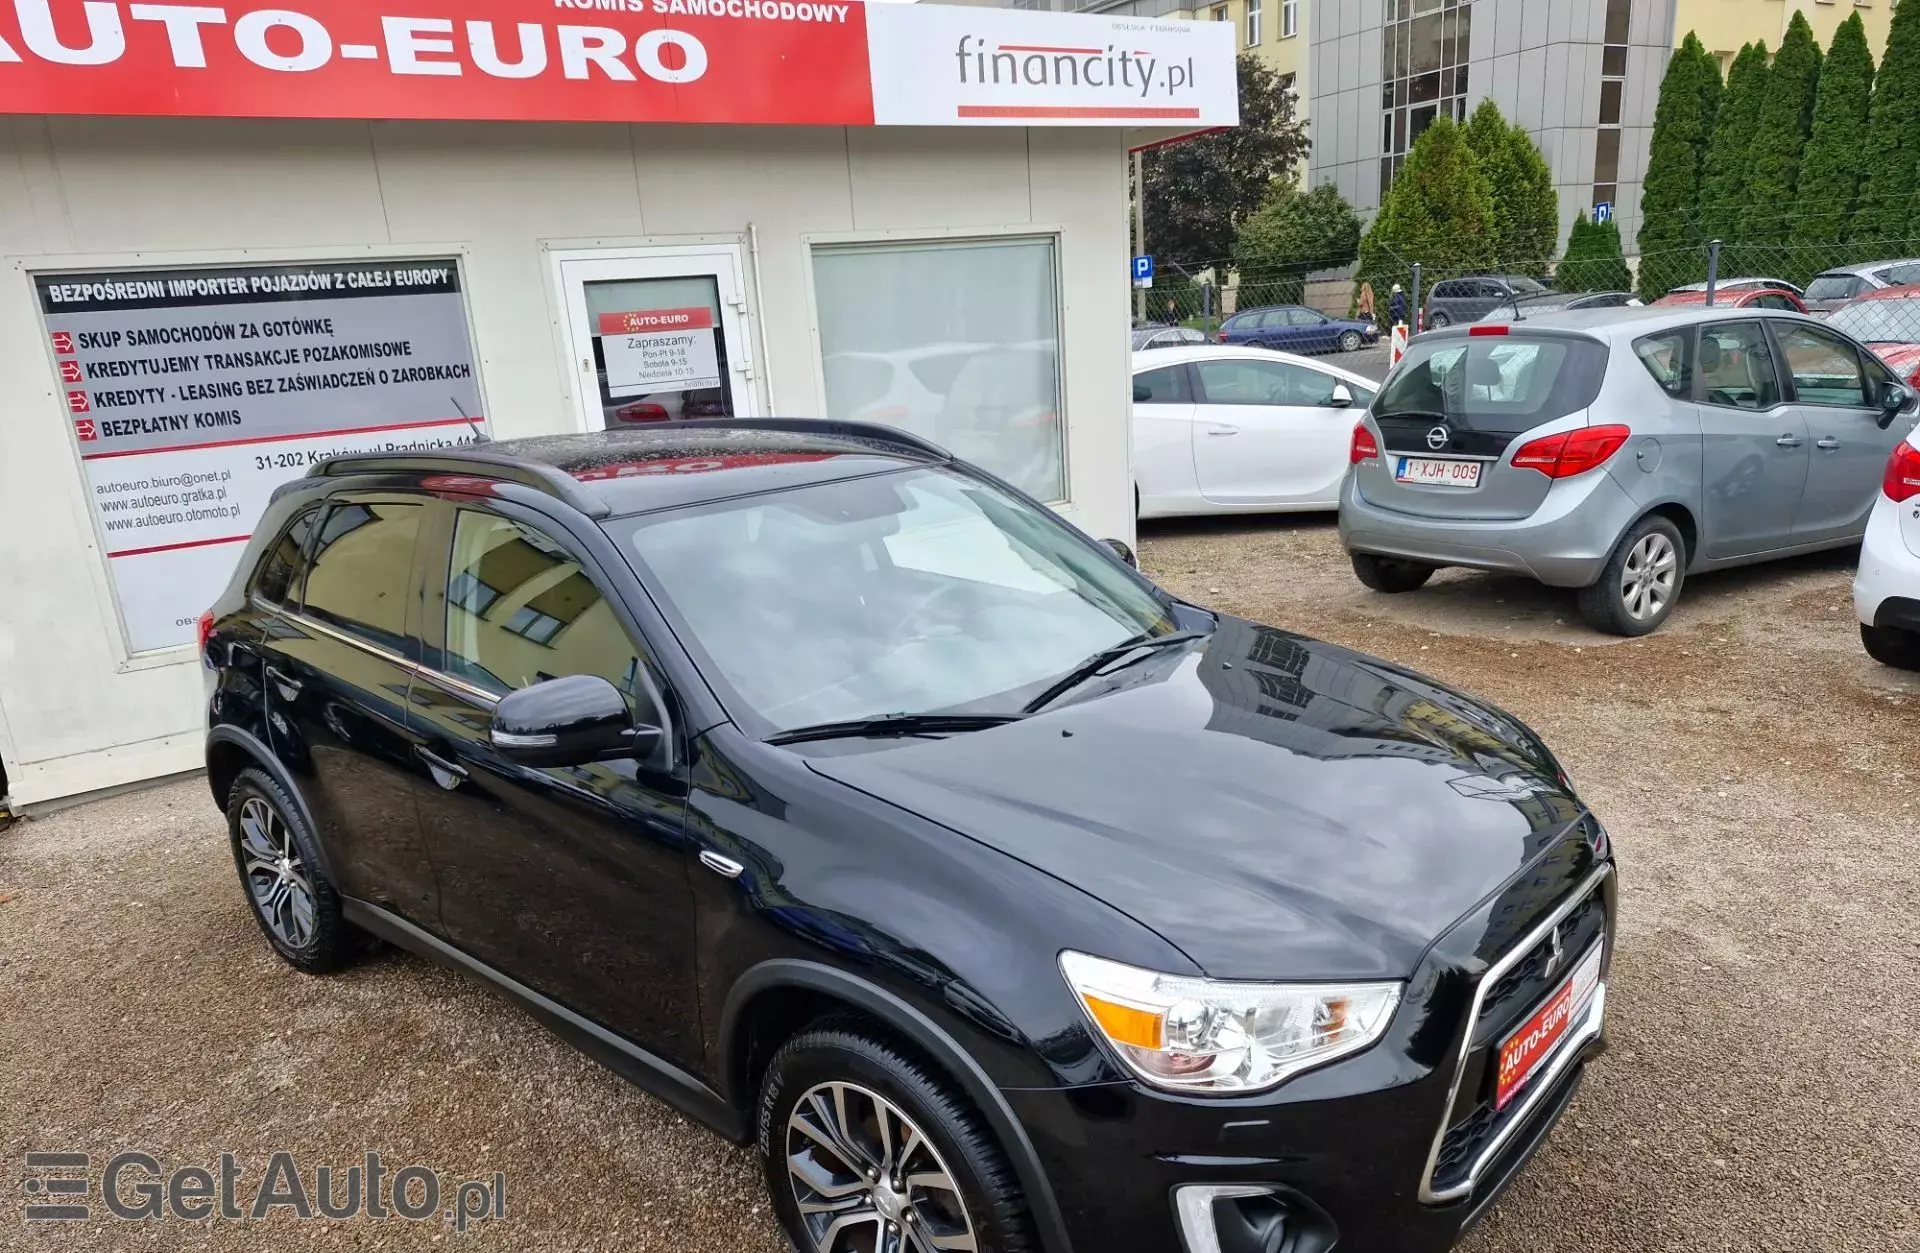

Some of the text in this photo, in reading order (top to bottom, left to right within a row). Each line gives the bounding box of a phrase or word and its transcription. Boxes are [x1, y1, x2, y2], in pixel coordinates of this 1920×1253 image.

[652, 0, 848, 23] SAMOCHODOWY
[0, 0, 707, 83] UTO-EURO
[955, 35, 1194, 97] financity.pl
[1138, 259, 1148, 276] P
[49, 268, 448, 302] BEZPOŚREDNI IMPORTER POJAZDÓW Z CAŁEJ EUROPY
[79, 317, 334, 349] SKUP SAMOCHODÓW ZA GOTÓWKĘ
[630, 314, 689, 327] AUTO-EURO
[627, 335, 697, 350] Zapraszamy:
[86, 341, 412, 379] KREDYTUJEMY TRANSAKCJE POZAKOMISOWE
[94, 388, 165, 408] KREDYTY
[179, 381, 242, 401] LEASING
[247, 378, 274, 395] BEZ
[278, 368, 376, 392] ZAŚWIADCZEŃ
[379, 369, 388, 384] O
[392, 364, 470, 384] ZAROBKACH
[101, 409, 241, 437] BEZPŁATNY KOMIS
[255, 452, 304, 470] 31-202
[96, 469, 232, 494] autoeuro.biuro@onet.pl
[100, 486, 227, 512] www.autoeuro.gratka.pl
[105, 502, 241, 531] www.autoeuro.otomoto.pl
[1504, 995, 1570, 1075] AUTO-EURO
